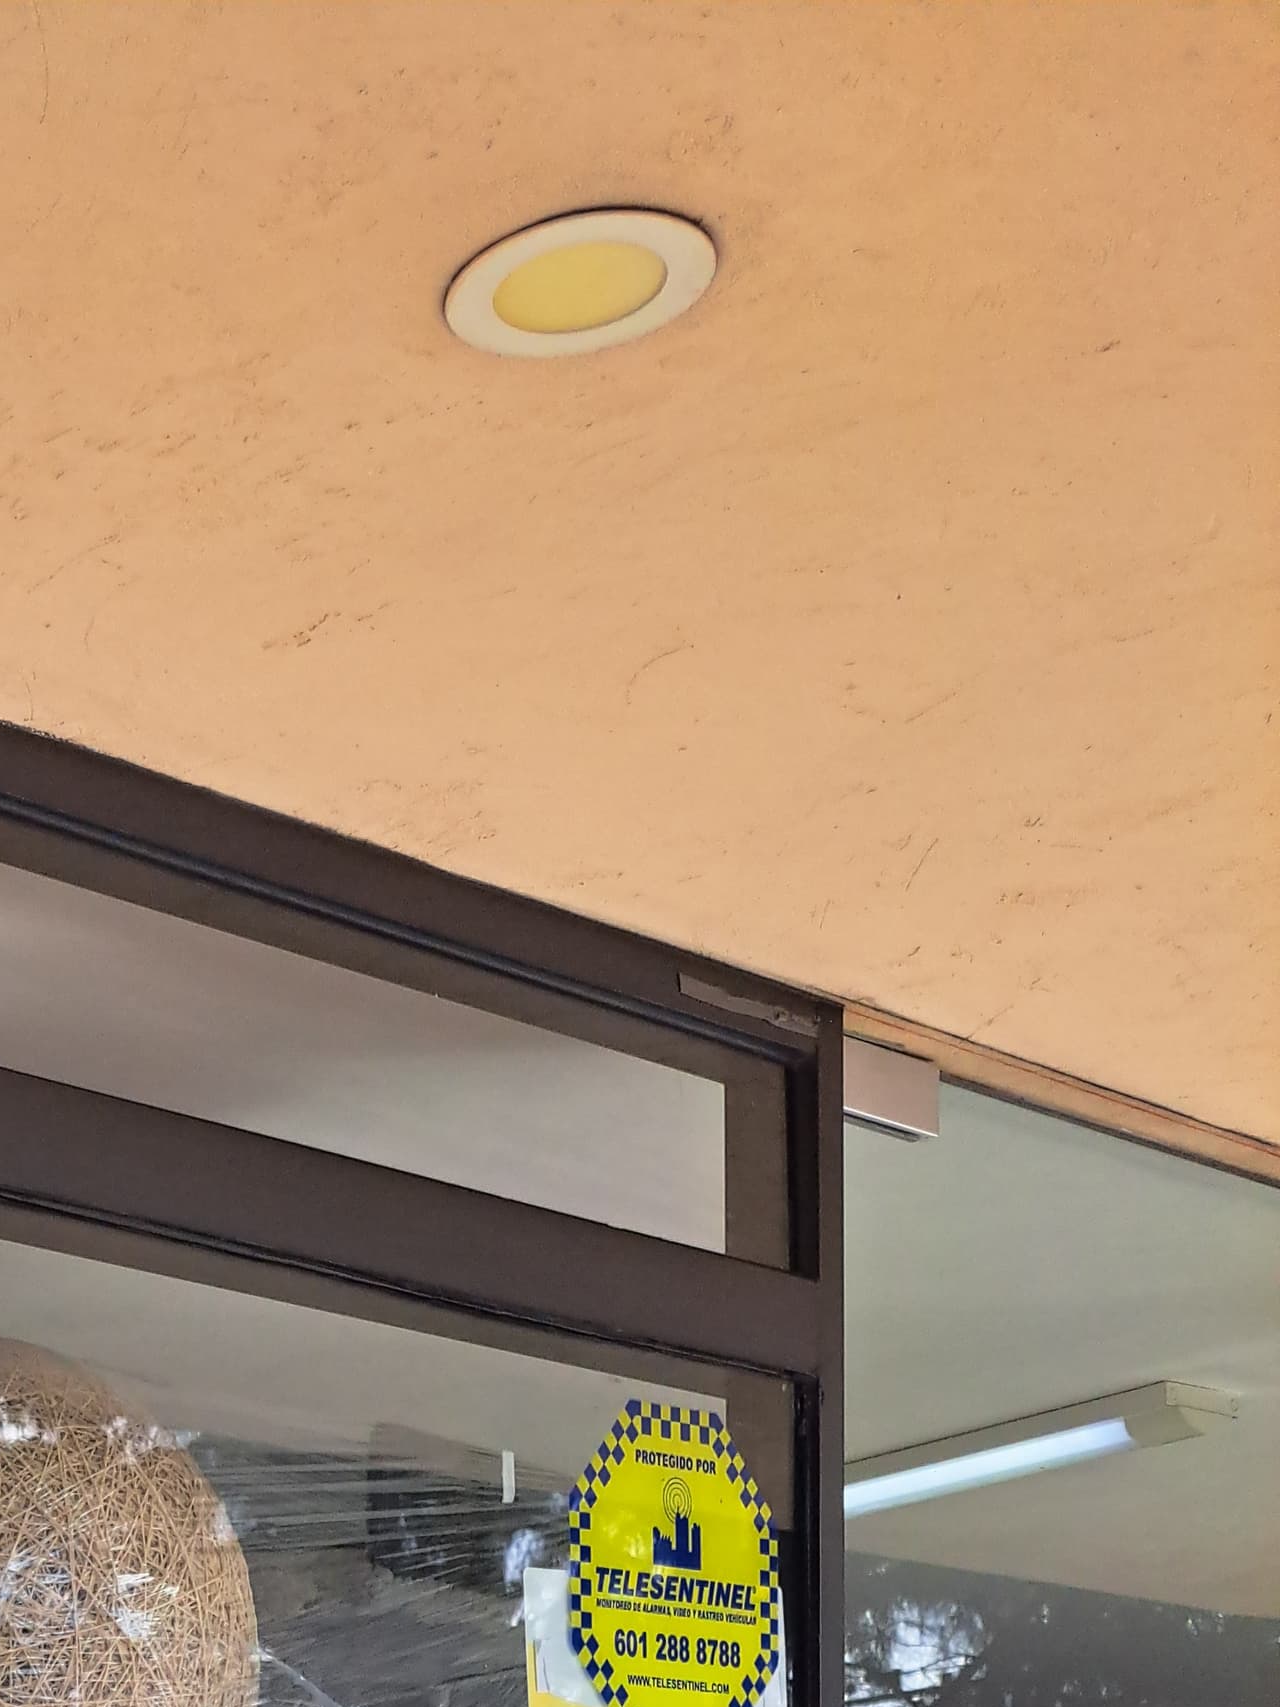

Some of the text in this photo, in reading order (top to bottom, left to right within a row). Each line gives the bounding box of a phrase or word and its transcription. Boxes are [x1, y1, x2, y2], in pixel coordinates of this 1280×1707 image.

[635, 1449, 716, 1474] PROTEGIDO POR
[596, 1566, 757, 1611] TELESENTINEL
[596, 1598, 631, 1611] MONITOREO
[633, 1602, 641, 1611] DE
[673, 1609, 690, 1618] VIDEO
[692, 1610, 697, 1618] Y
[698, 1611, 724, 1622] RASTREO
[725, 1614, 757, 1625] VEHICULAR
[614, 1629, 741, 1668] 601 288 8788
[627, 1674, 730, 1695] WWW.TELESENTINEL.COM
